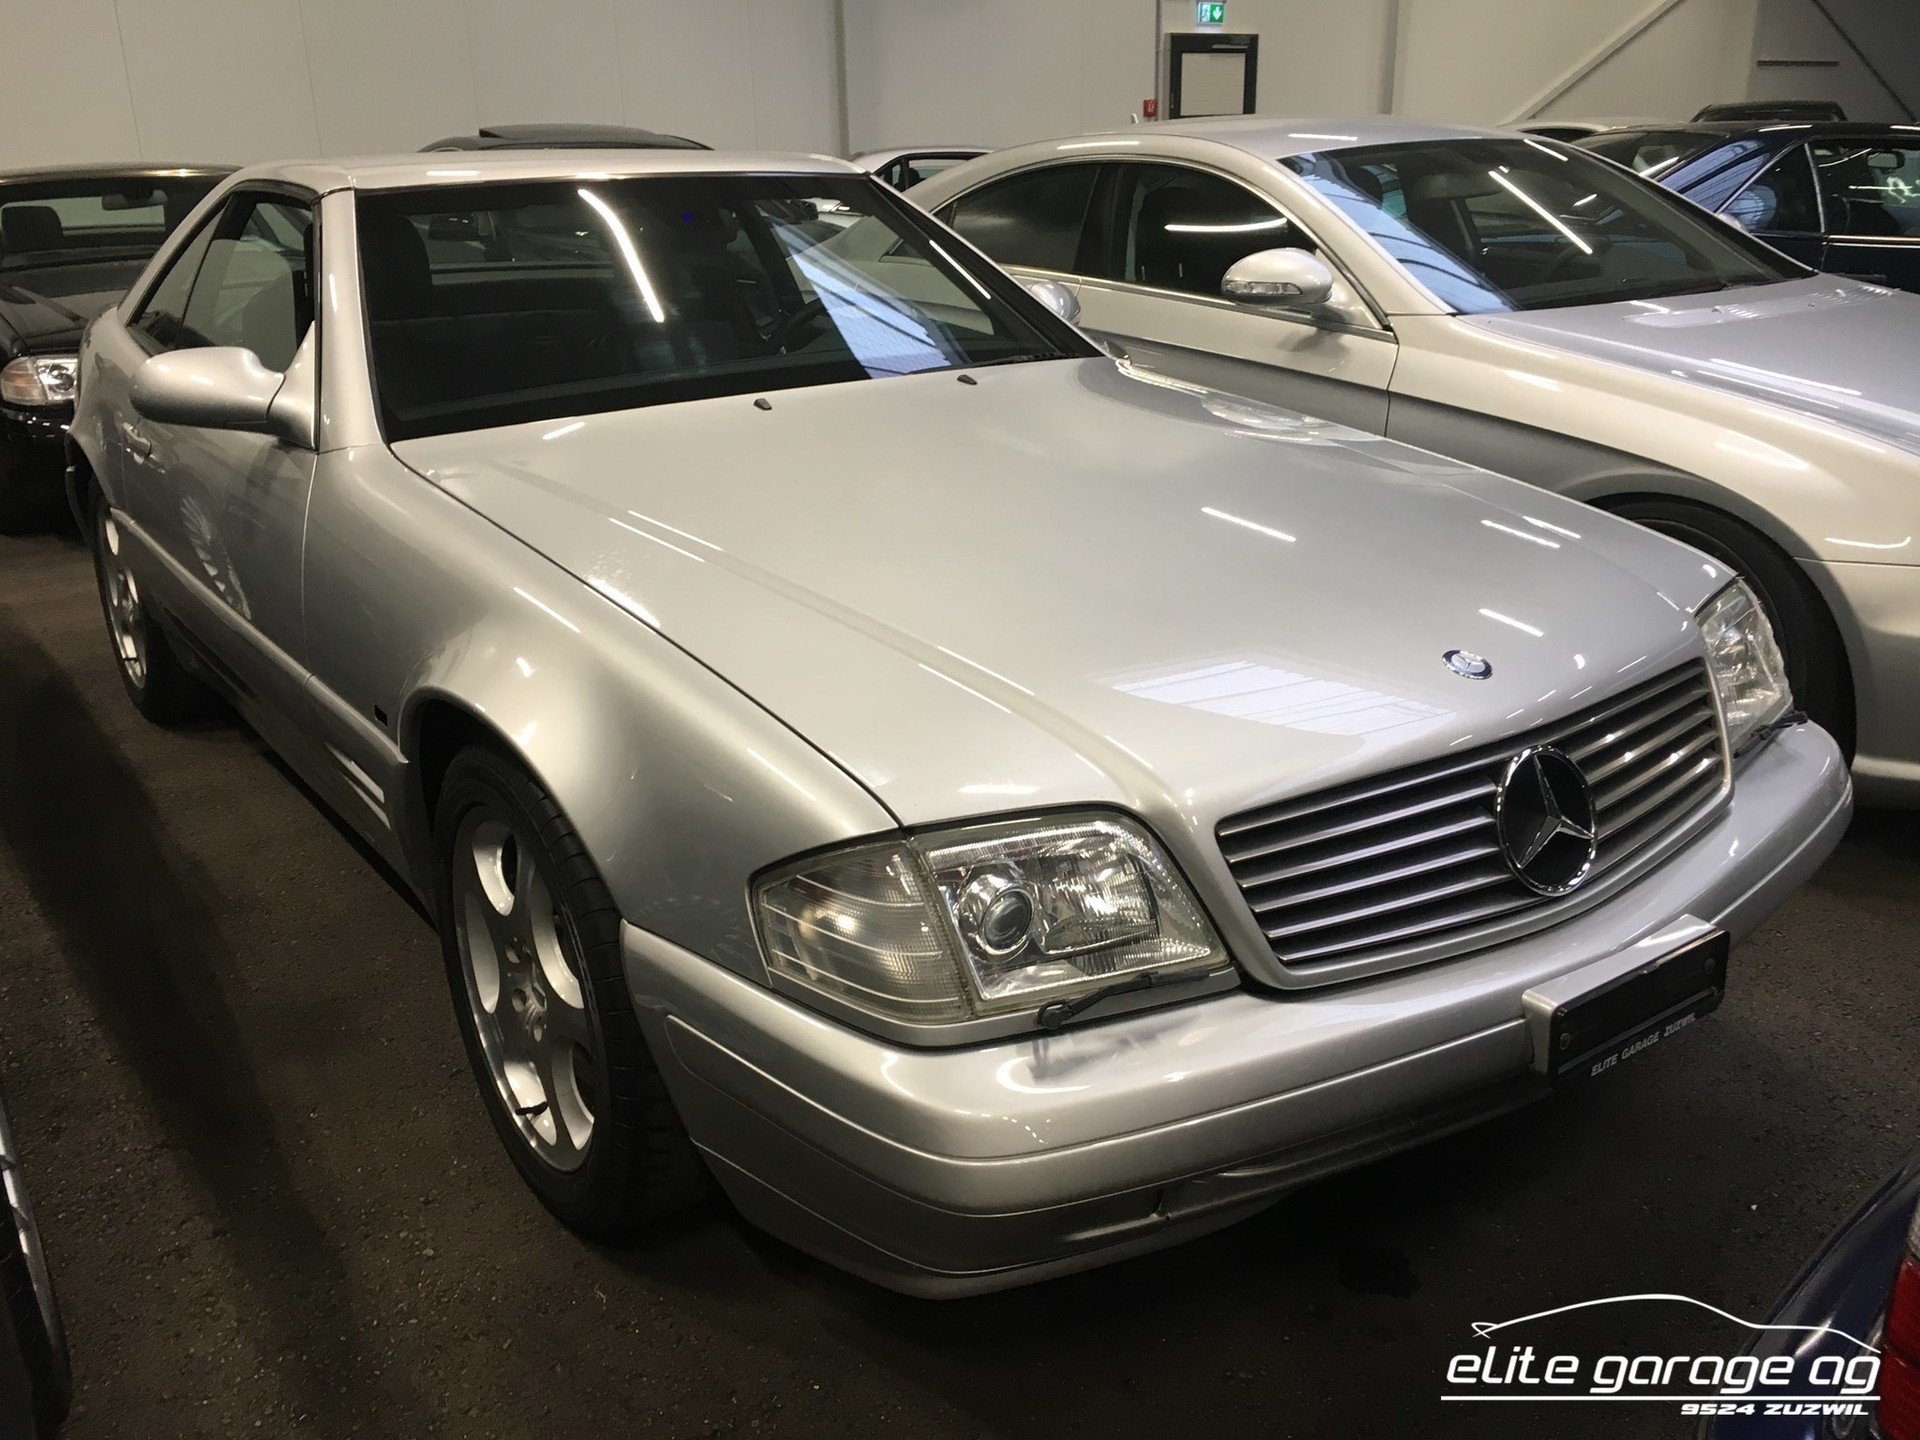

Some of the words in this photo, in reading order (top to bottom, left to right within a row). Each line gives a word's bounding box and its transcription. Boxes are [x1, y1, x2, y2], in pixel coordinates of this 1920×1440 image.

[1590, 1053, 1619, 1077] ELITE
[1621, 1031, 1661, 1060] GARAGE
[1663, 1012, 1697, 1037] ZUZWIL
